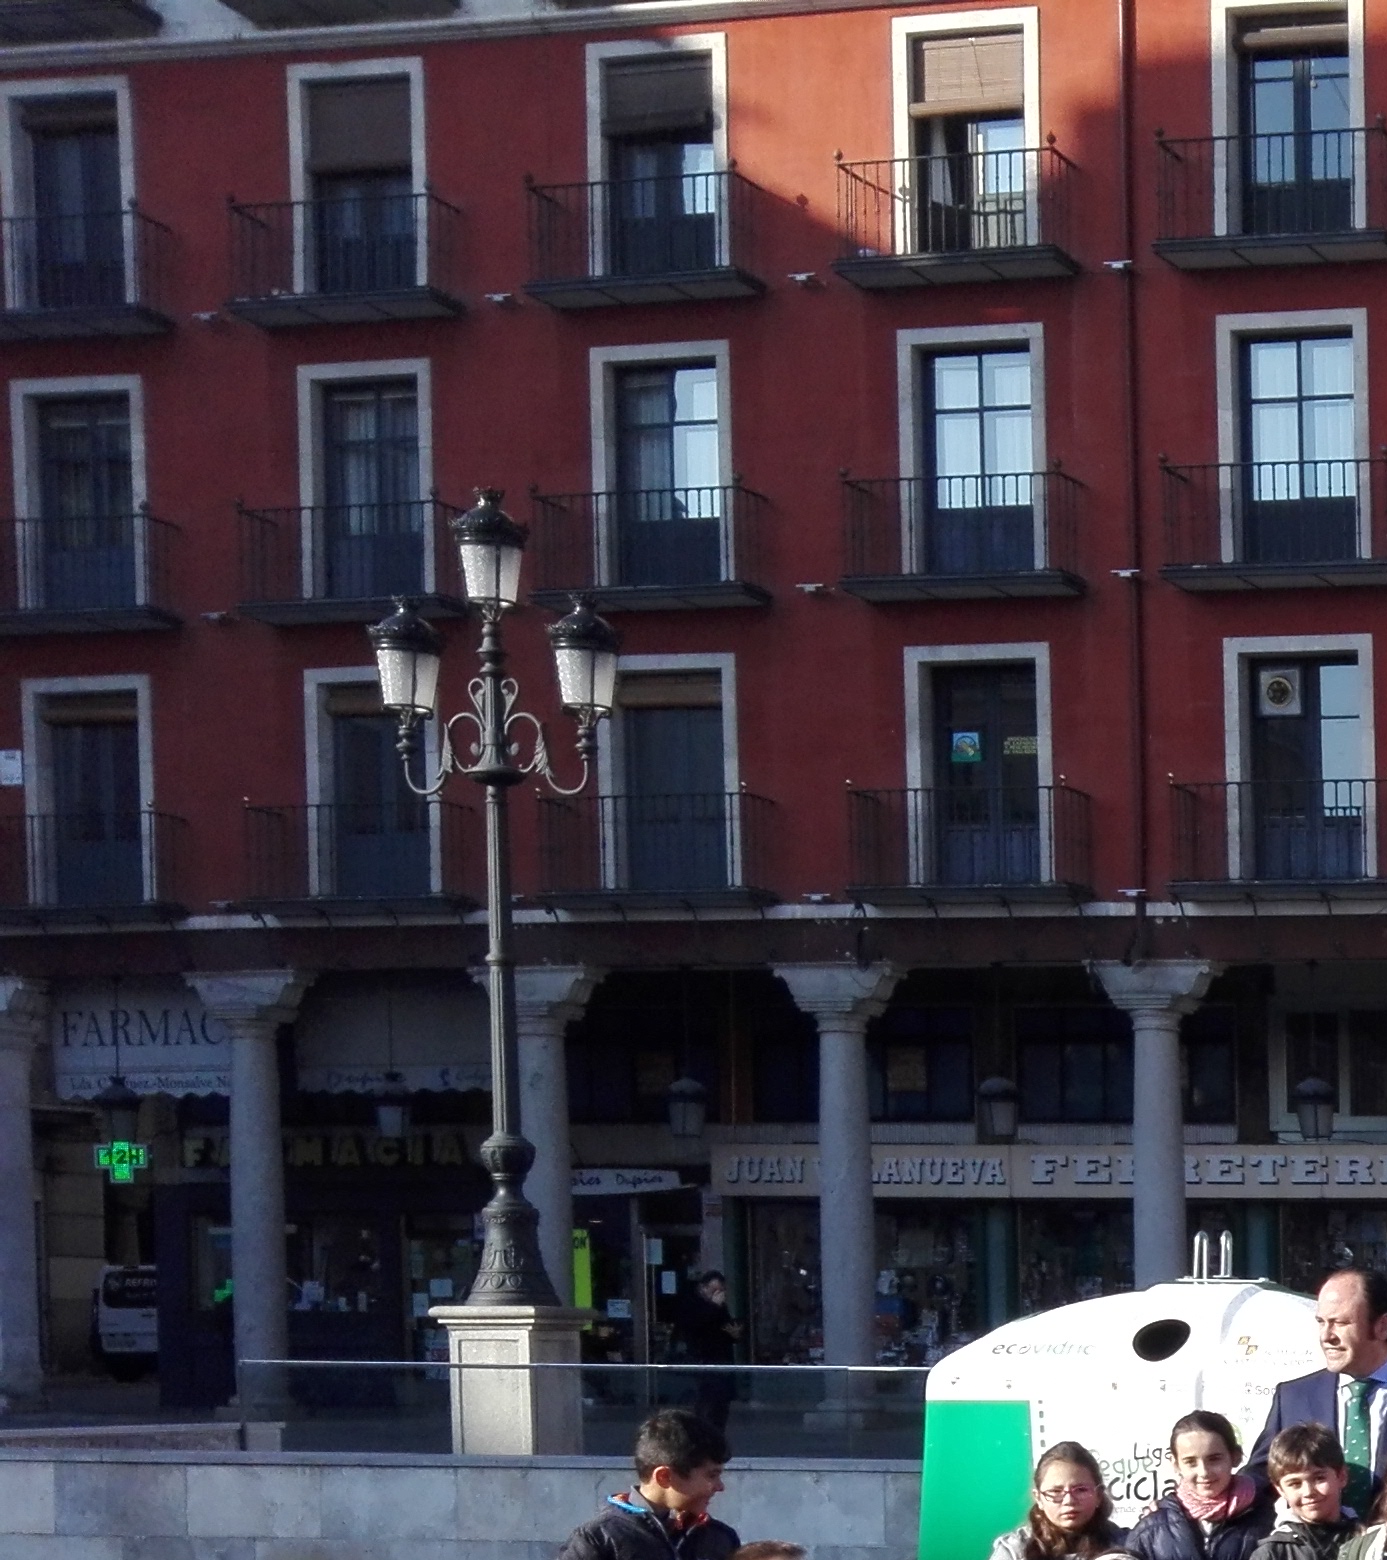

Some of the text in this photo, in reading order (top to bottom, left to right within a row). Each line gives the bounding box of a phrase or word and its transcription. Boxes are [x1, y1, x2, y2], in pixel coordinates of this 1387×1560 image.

[61, 1009, 225, 1047] FARMAC
[183, 1135, 462, 1168] FAMACIA
[725, 1156, 1006, 1186] JUAN LANUEVA
